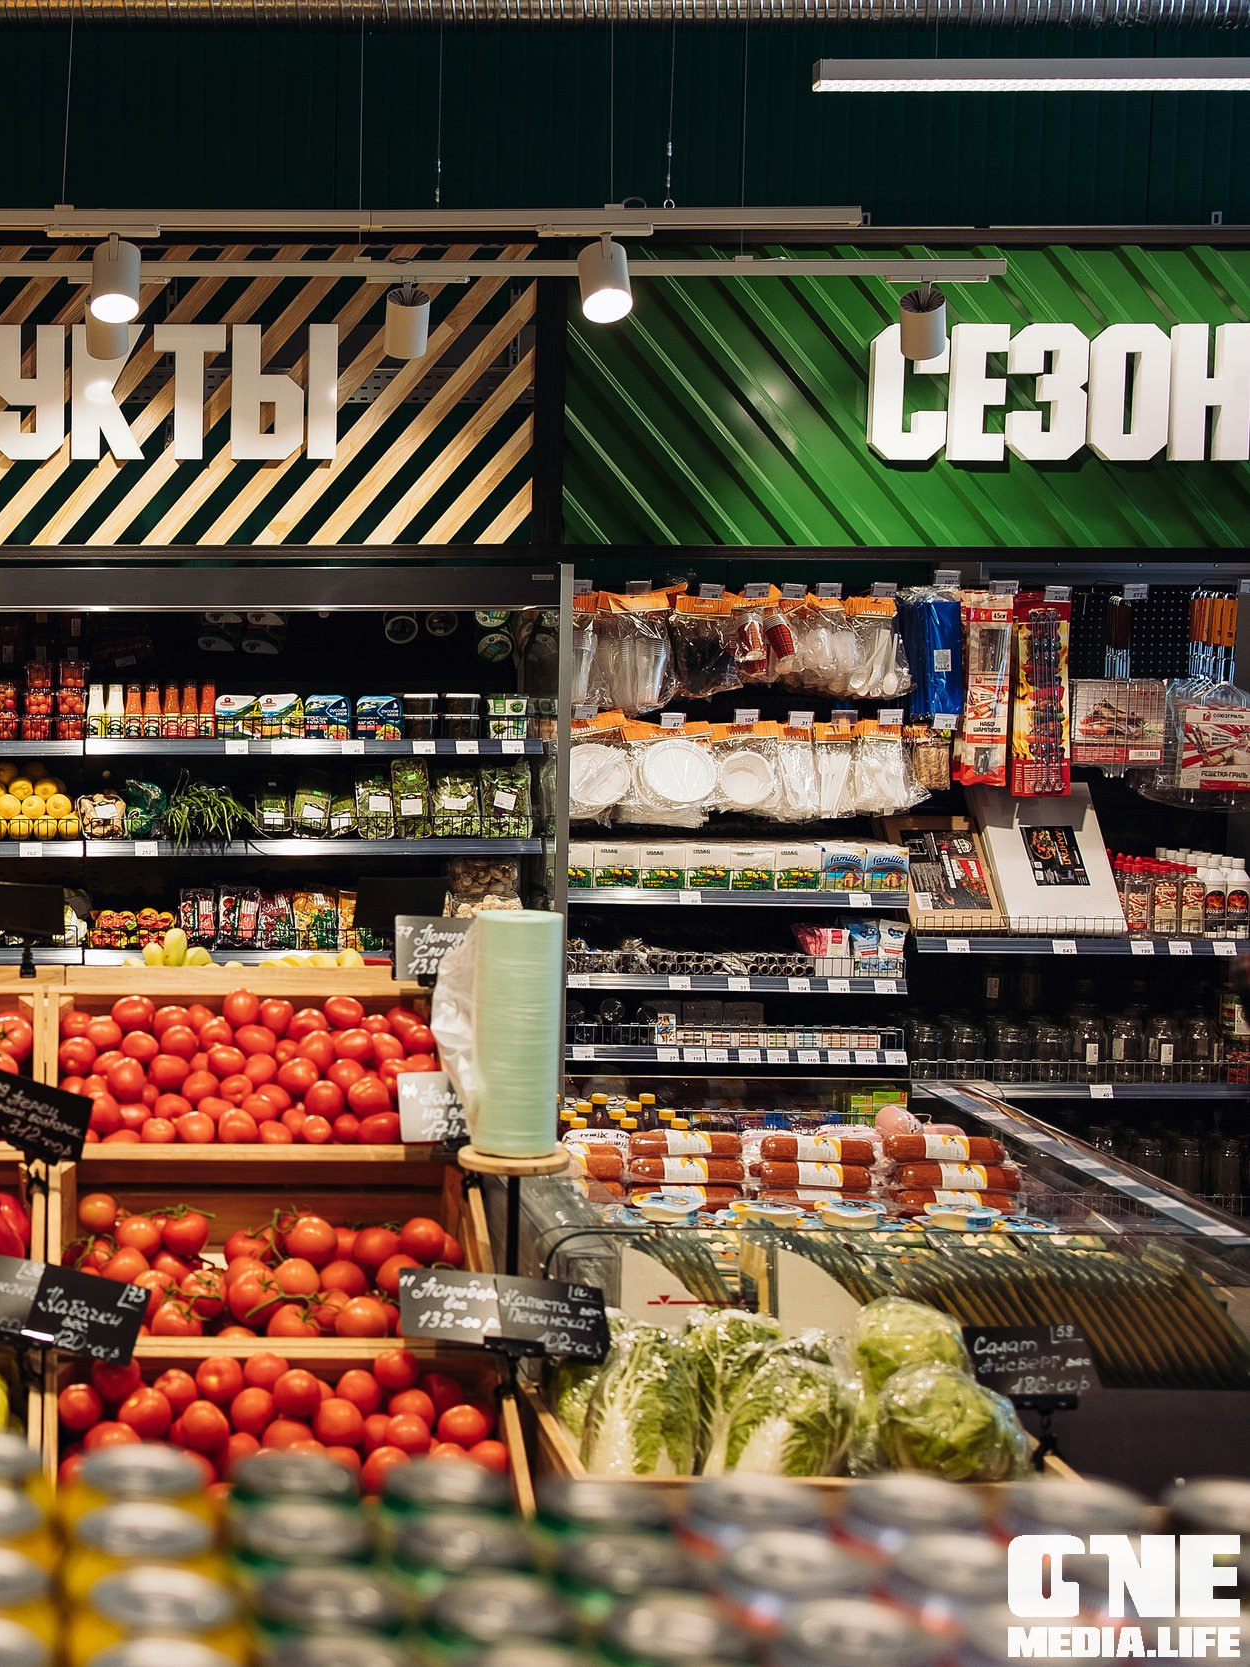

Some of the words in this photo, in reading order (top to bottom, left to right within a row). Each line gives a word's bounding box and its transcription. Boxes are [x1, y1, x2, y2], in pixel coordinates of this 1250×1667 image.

[829, 854, 862, 866] familia
[873, 855, 905, 867] familia
[37, 1286, 124, 1327] Кабачки
[973, 1336, 1038, 1355] Салат
